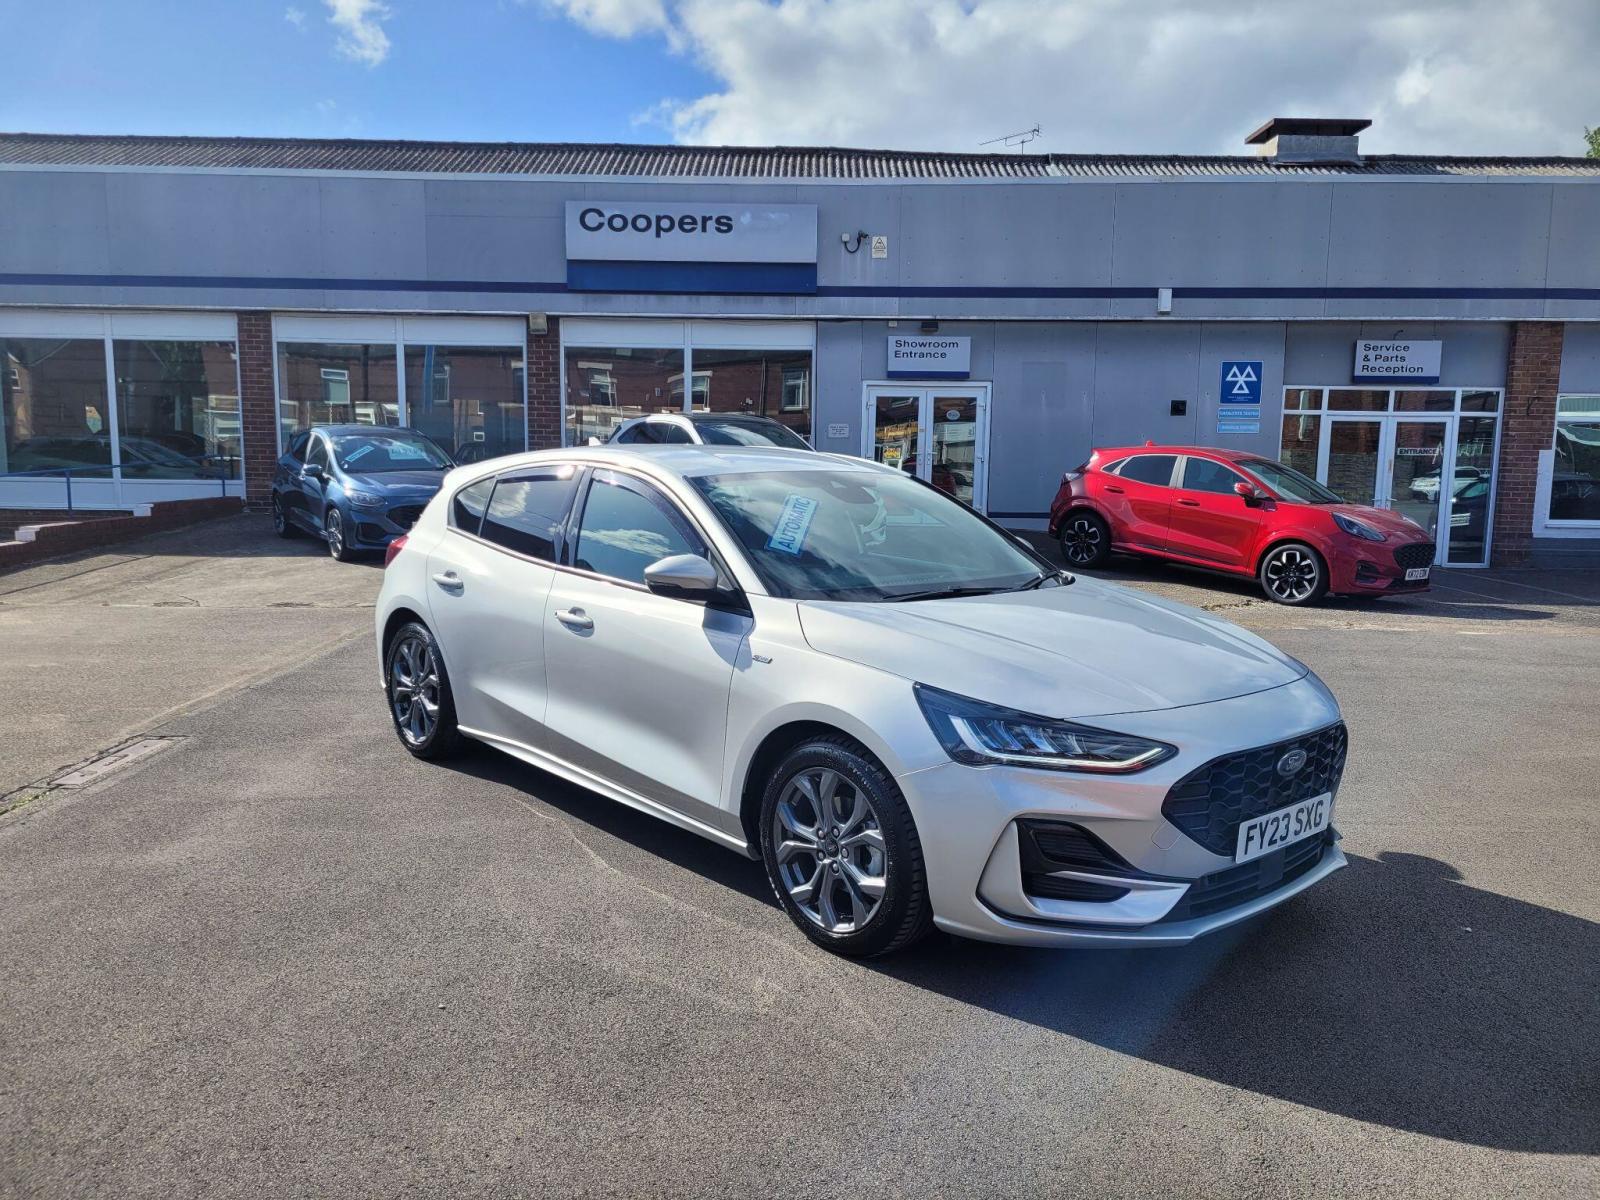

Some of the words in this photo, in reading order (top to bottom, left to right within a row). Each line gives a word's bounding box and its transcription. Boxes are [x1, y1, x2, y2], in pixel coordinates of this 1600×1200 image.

[579, 208, 734, 238] Coopers
[895, 340, 959, 349] Showroom
[1363, 343, 1410, 352] Service
[894, 350, 947, 359] Entrance
[1362, 354, 1370, 362] &
[1374, 354, 1407, 362] Parts
[1361, 364, 1424, 374] Reception
[777, 497, 810, 550] AUTOMATIC
[1244, 812, 1292, 855] FY23
[1294, 799, 1324, 836] SXG
